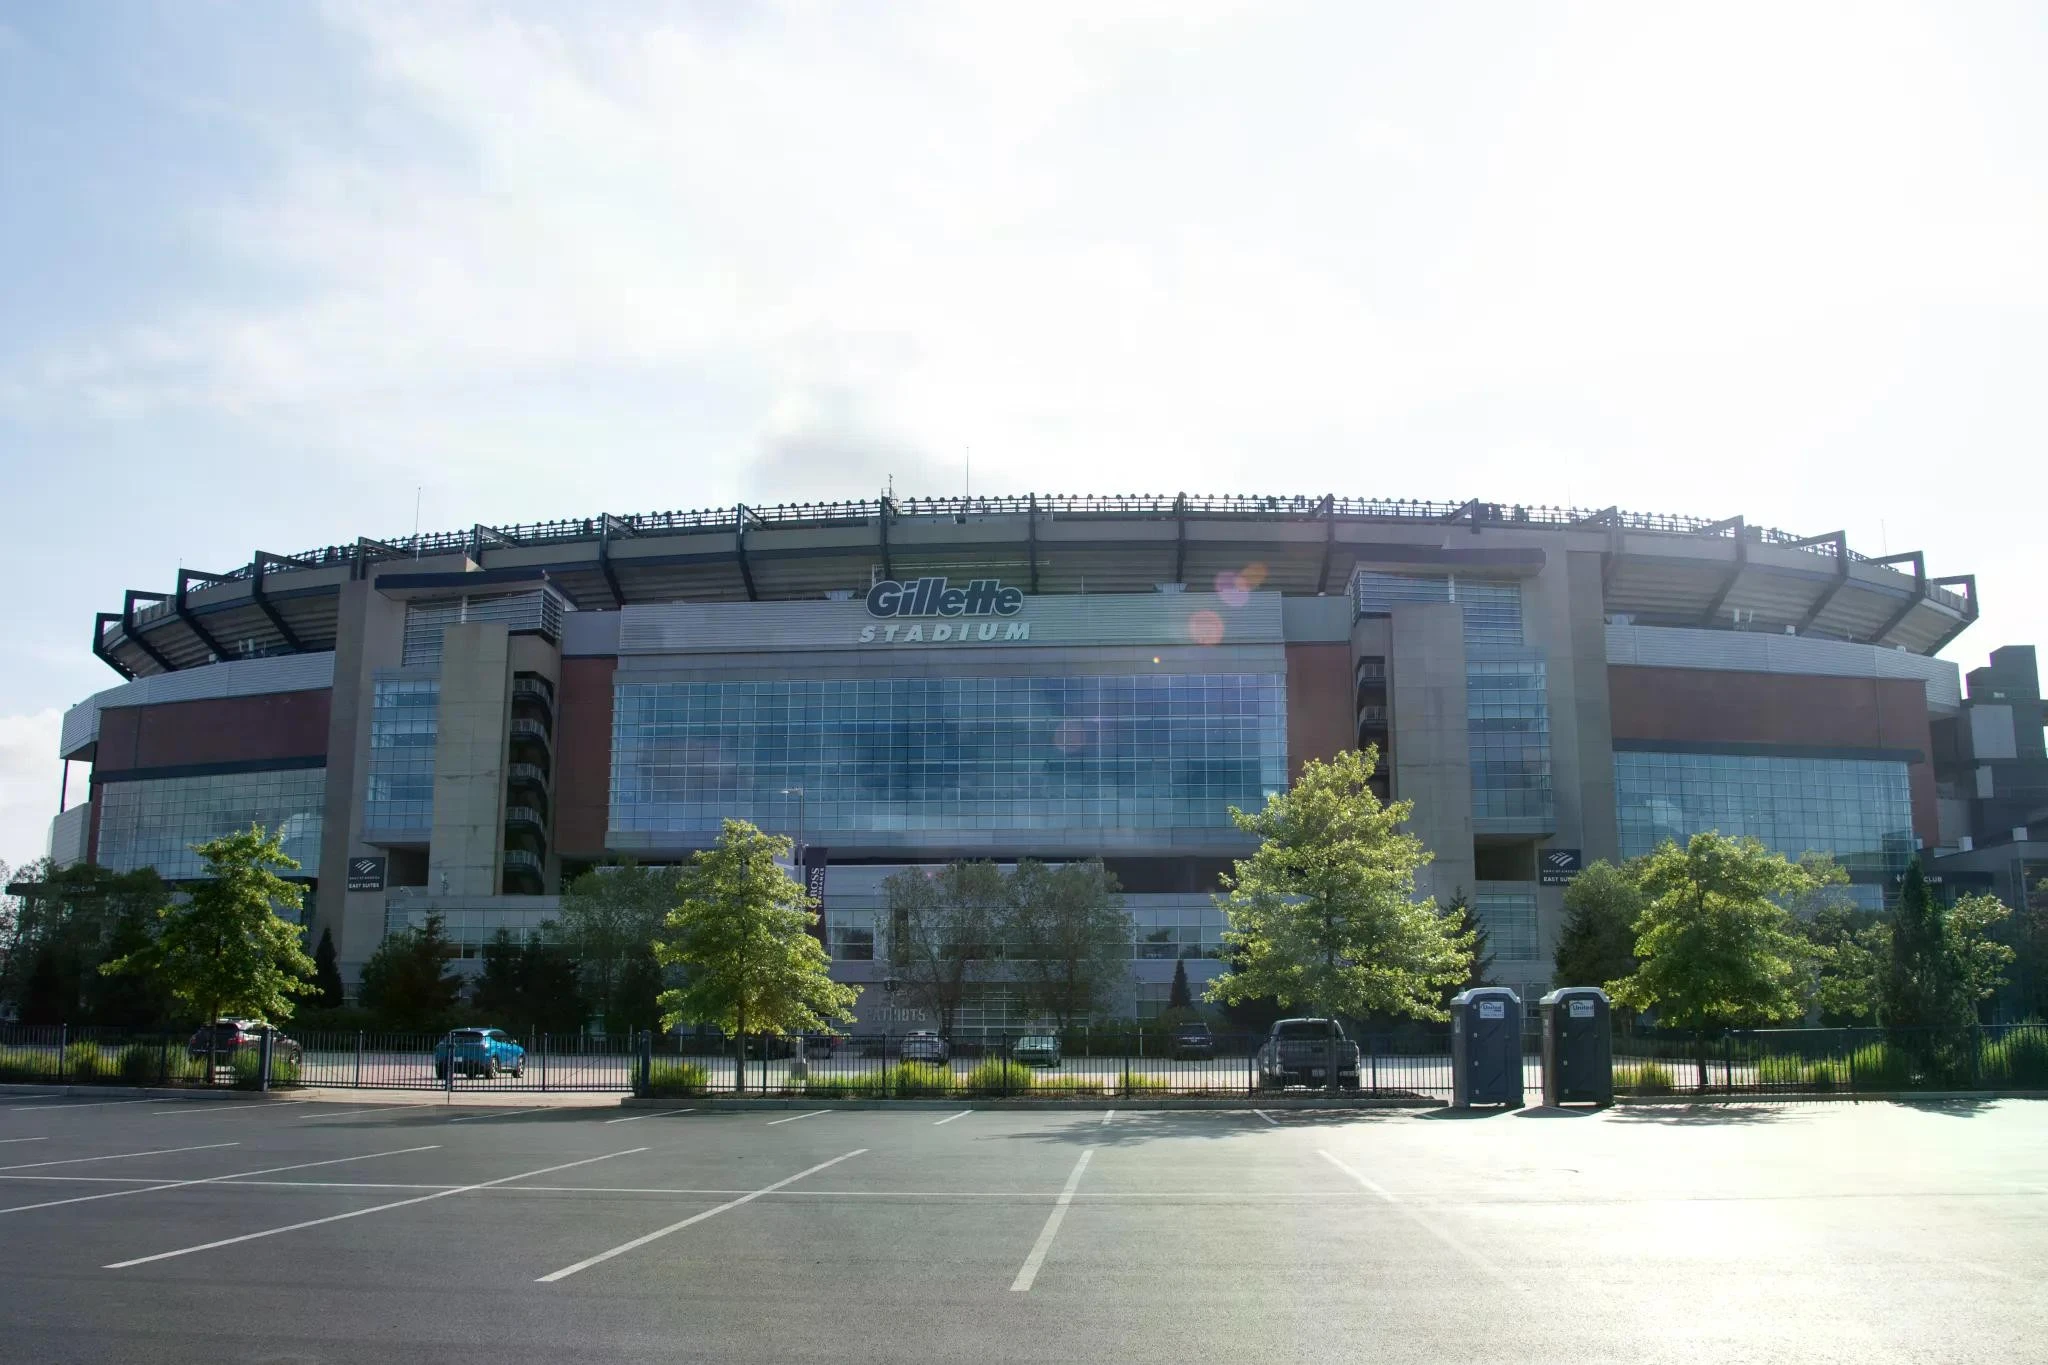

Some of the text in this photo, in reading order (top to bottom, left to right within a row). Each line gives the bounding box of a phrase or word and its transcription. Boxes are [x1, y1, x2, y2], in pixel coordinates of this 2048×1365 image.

[866, 577, 1023, 618] Gillette
[858, 622, 1030, 643] STADIUM
[1923, 875, 1943, 883] CLUB
[865, 1008, 928, 1022] PATRIOTS
